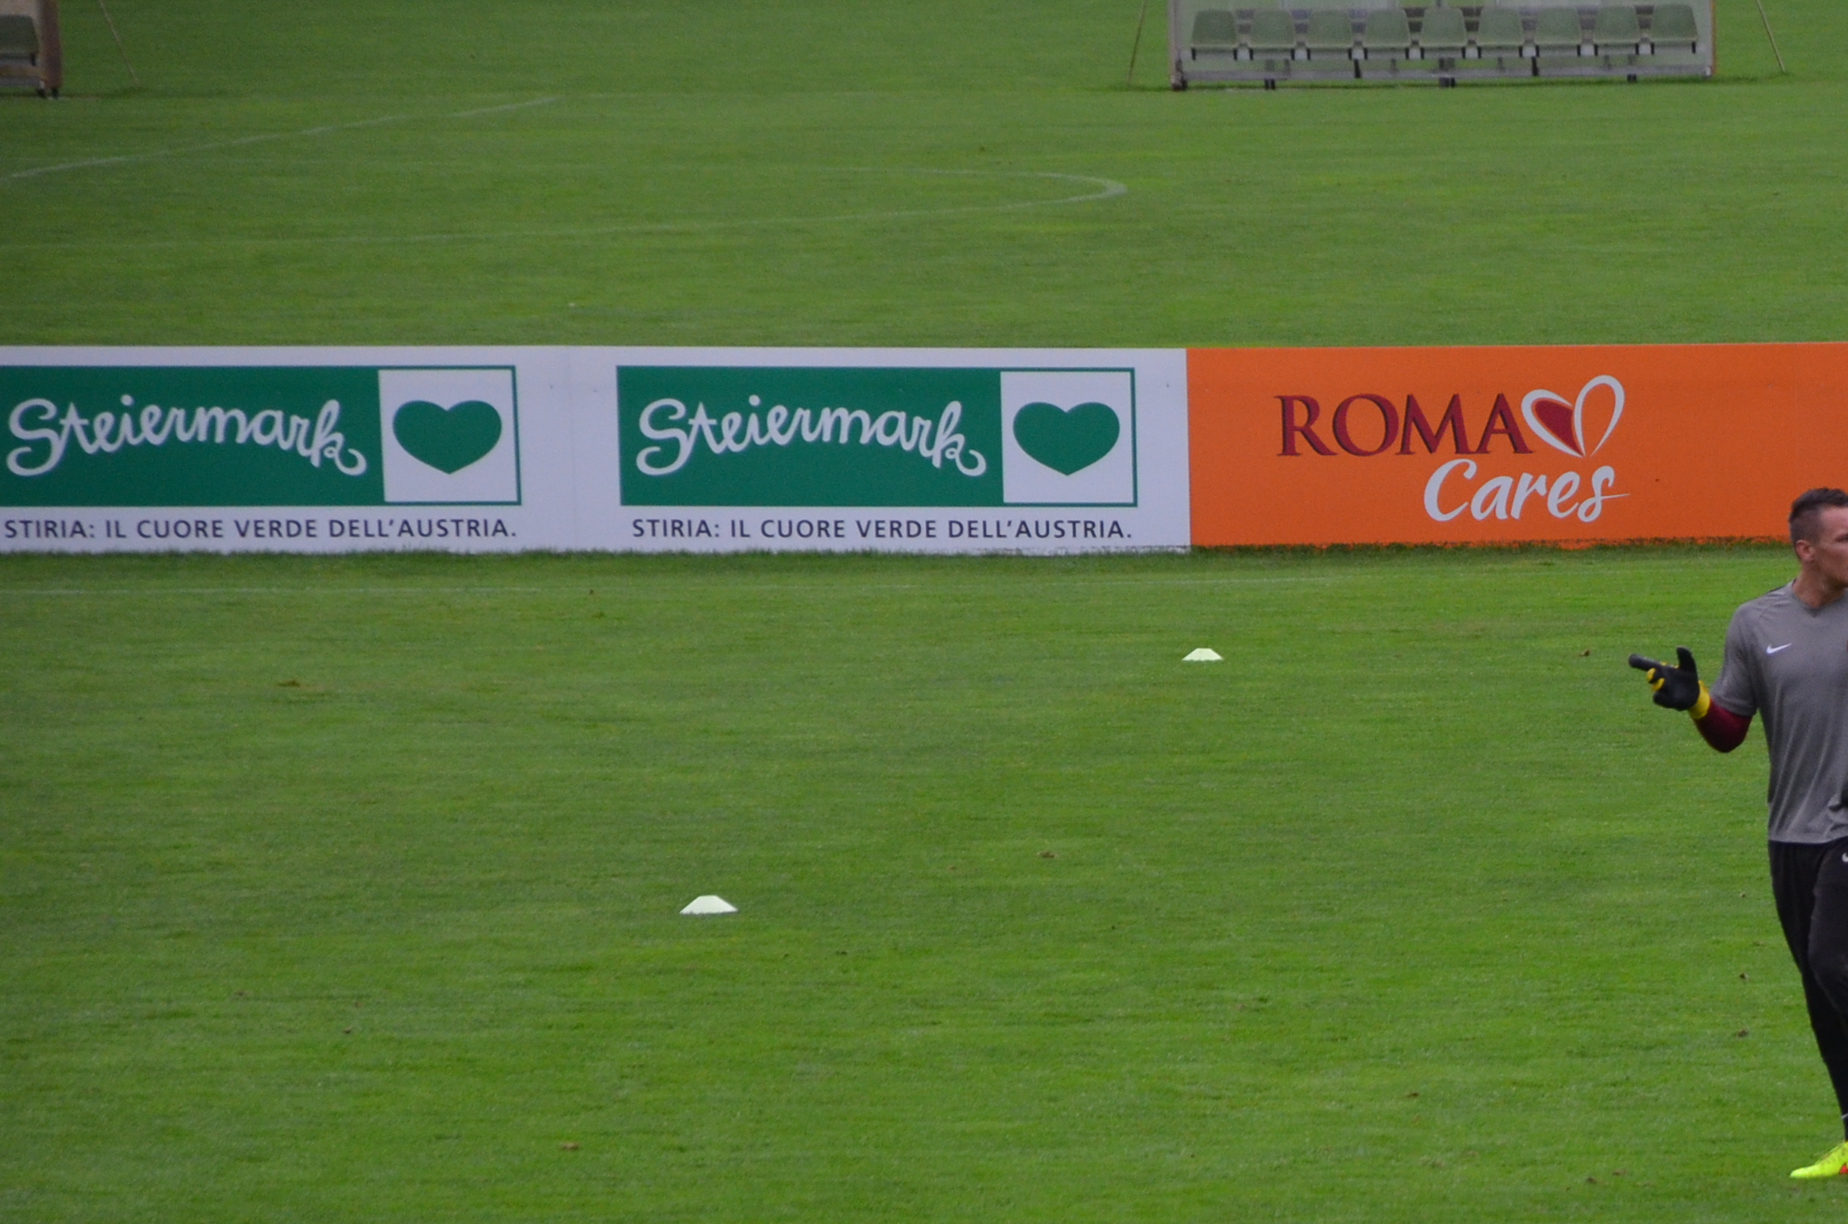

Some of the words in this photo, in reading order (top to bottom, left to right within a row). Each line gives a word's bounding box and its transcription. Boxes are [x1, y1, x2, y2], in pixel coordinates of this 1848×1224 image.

[6, 394, 367, 477] Steiermark
[635, 394, 988, 477] Steiermark
[1274, 393, 1536, 458] ROMA
[1423, 459, 1631, 523] Cares
[4, 519, 95, 539] STIRIA:
[106, 519, 127, 539] IL
[137, 519, 223, 539] CUORE
[234, 519, 317, 539] VERDE
[329, 518, 517, 538] DELL'AUSTRIA.
[632, 518, 720, 538] STIRIA:
[731, 519, 751, 538] IL
[760, 519, 845, 538] CUORE
[856, 519, 937, 538] VERDE
[948, 520, 1132, 539] DELL'AUSTRIA.
